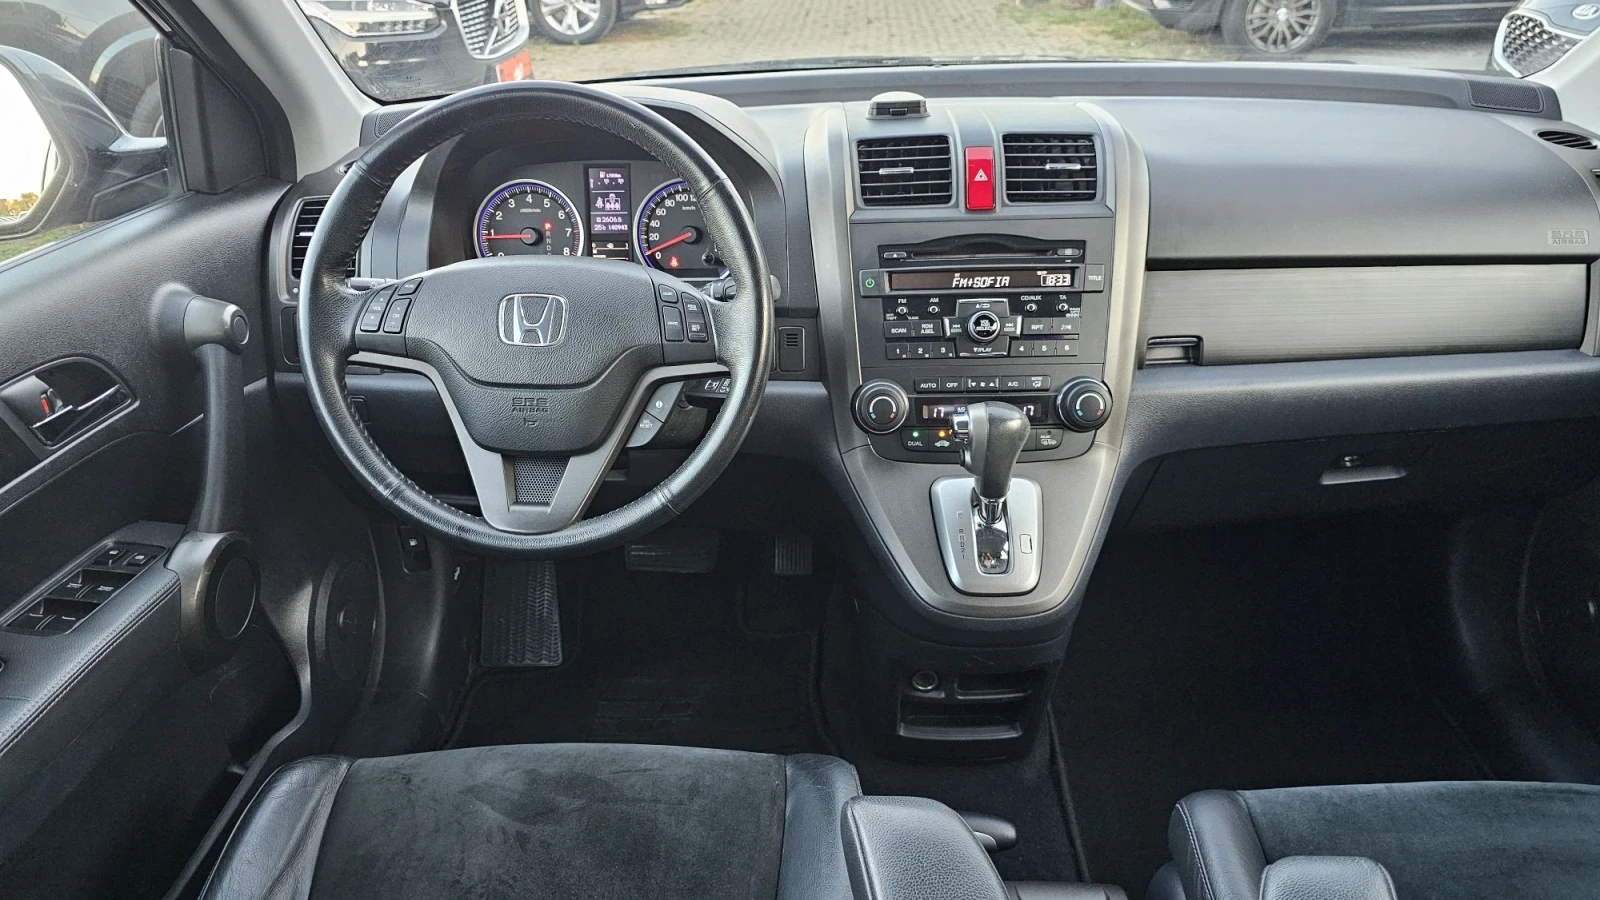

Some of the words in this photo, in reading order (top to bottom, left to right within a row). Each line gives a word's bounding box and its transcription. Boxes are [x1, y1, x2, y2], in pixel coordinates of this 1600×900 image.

[526, 194, 533, 203] 4
[675, 194, 689, 202] 100
[508, 198, 516, 208] 3
[543, 198, 551, 208] 5
[495, 211, 503, 220] 2
[558, 211, 566, 220] 6
[656, 208, 667, 216] 60
[565, 228, 572, 237] 7
[563, 247, 570, 256] 8
[952, 276, 1010, 288] FM+SOFIA
[933, 406, 945, 418] 17
[1022, 405, 1035, 416] 17
